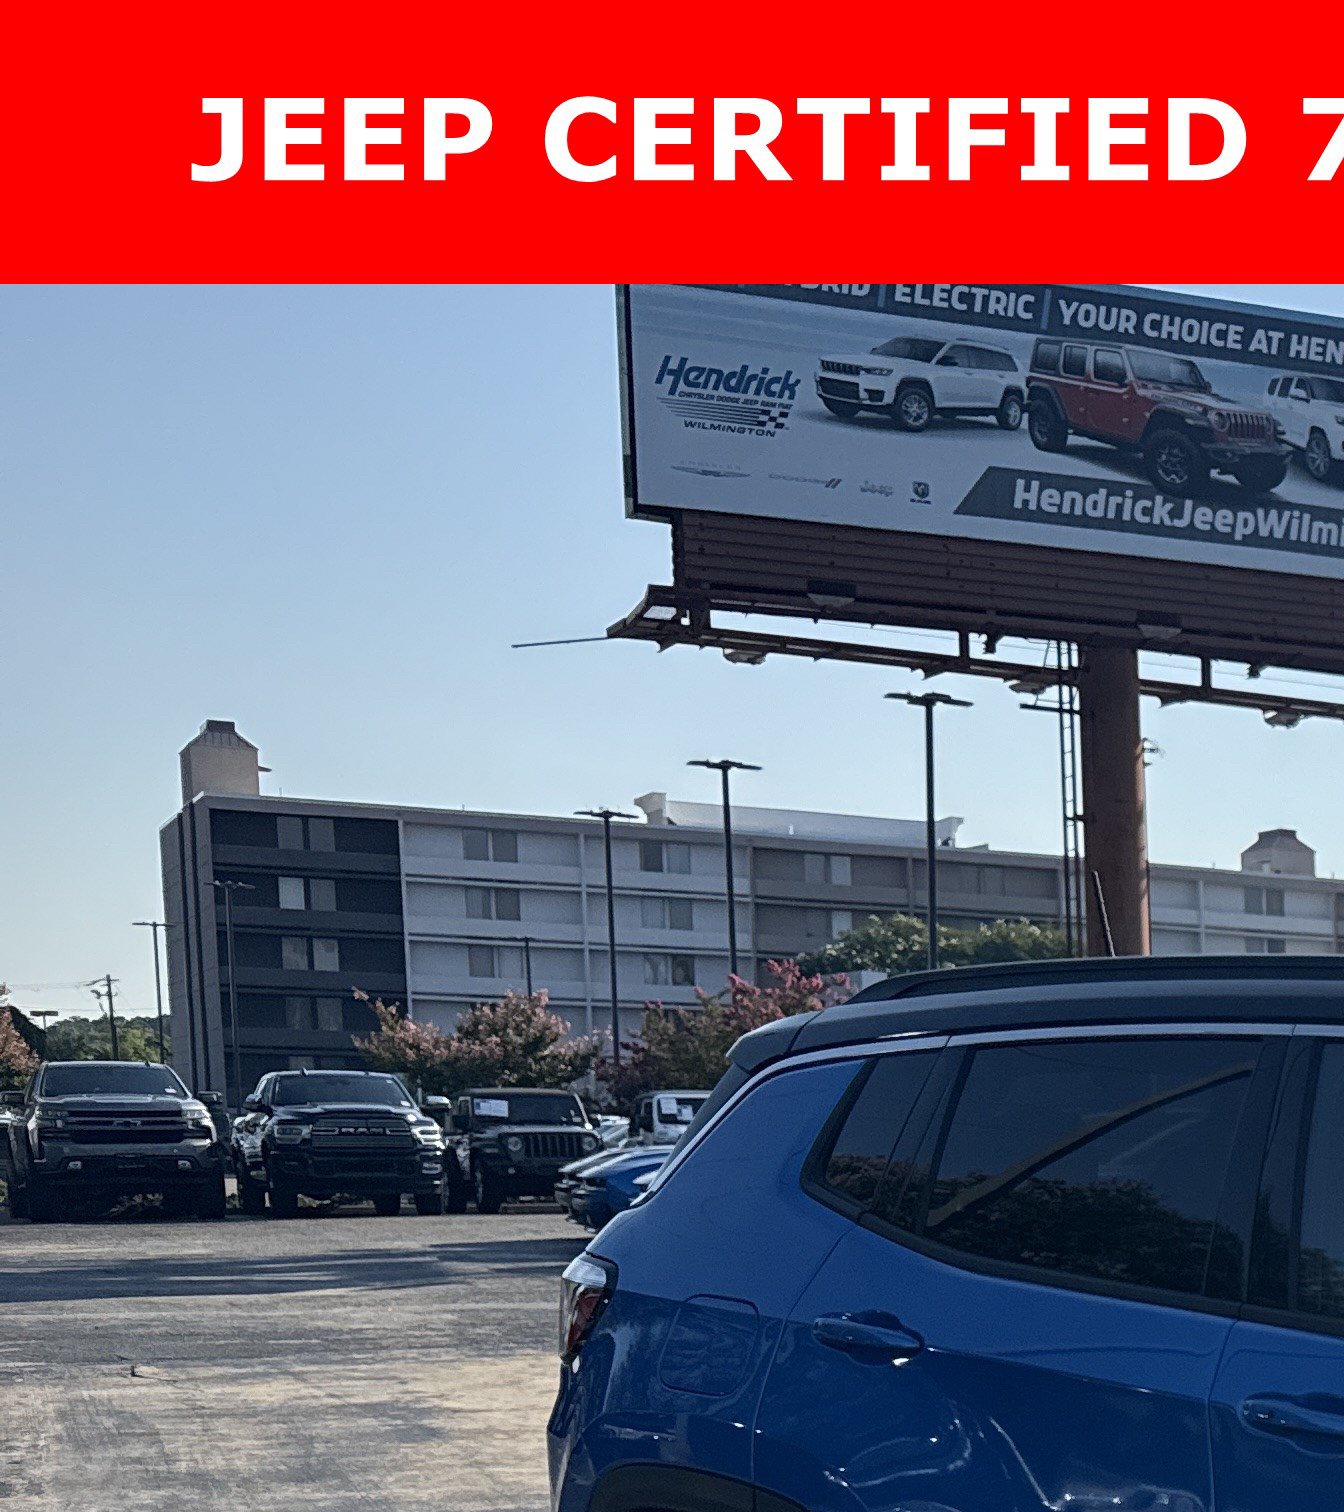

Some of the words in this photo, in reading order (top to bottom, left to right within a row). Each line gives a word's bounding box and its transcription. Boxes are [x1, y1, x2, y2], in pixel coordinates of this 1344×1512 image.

[893, 284, 1035, 320] ELECTRIC
[1058, 299, 1138, 335] YOUR
[1142, 312, 1245, 350] CHOICE
[1248, 328, 1285, 356] AT
[654, 354, 802, 401] Hendrick
[683, 418, 777, 438] WILMINGTON
